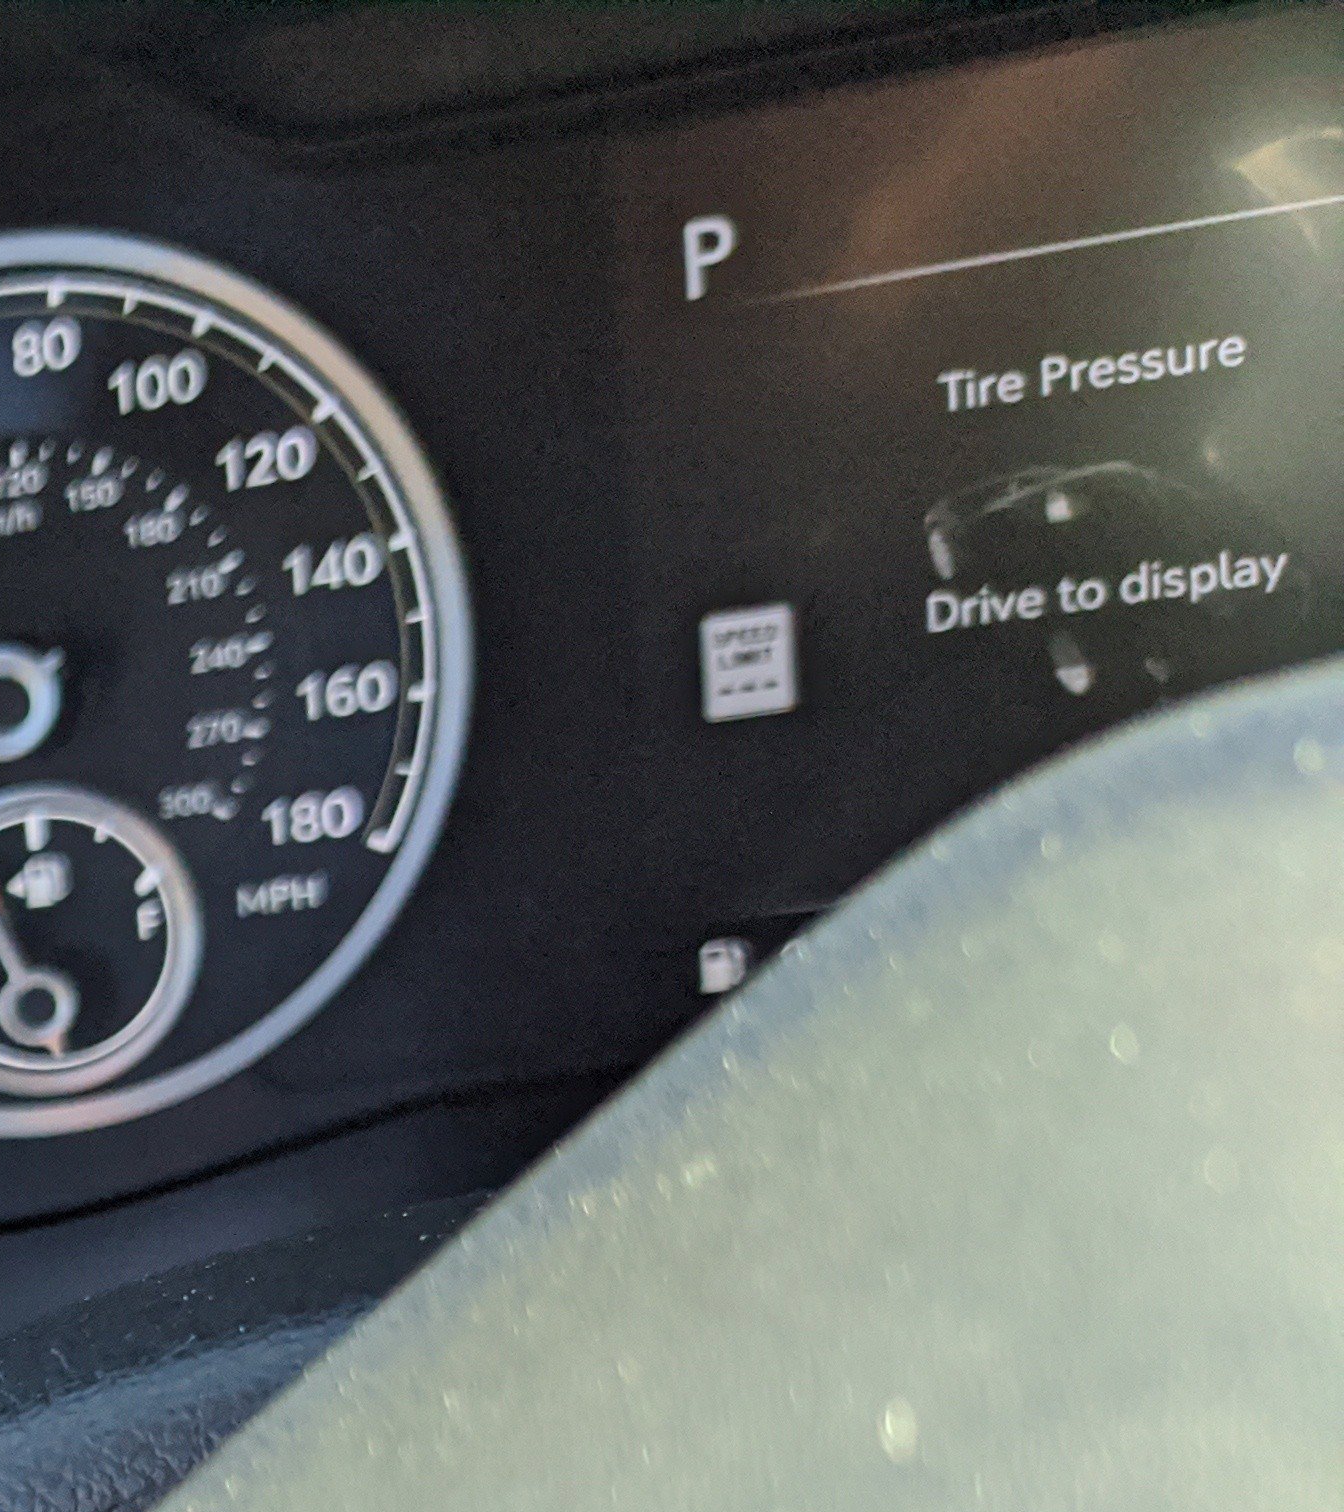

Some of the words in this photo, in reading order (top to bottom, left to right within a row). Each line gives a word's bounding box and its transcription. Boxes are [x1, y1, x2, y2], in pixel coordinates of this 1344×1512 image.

[683, 214, 737, 300] P
[12, 315, 81, 377] 80
[936, 366, 1025, 412] Tire
[1040, 334, 1247, 398] Pressure
[108, 349, 207, 414] 100
[216, 425, 318, 492] 120
[282, 530, 384, 597] 140
[925, 581, 1044, 634] Drive
[1056, 574, 1106, 615] to
[1119, 549, 1290, 606] display
[296, 659, 400, 721] 160
[261, 784, 364, 846] 180
[236, 870, 330, 918] MPH
